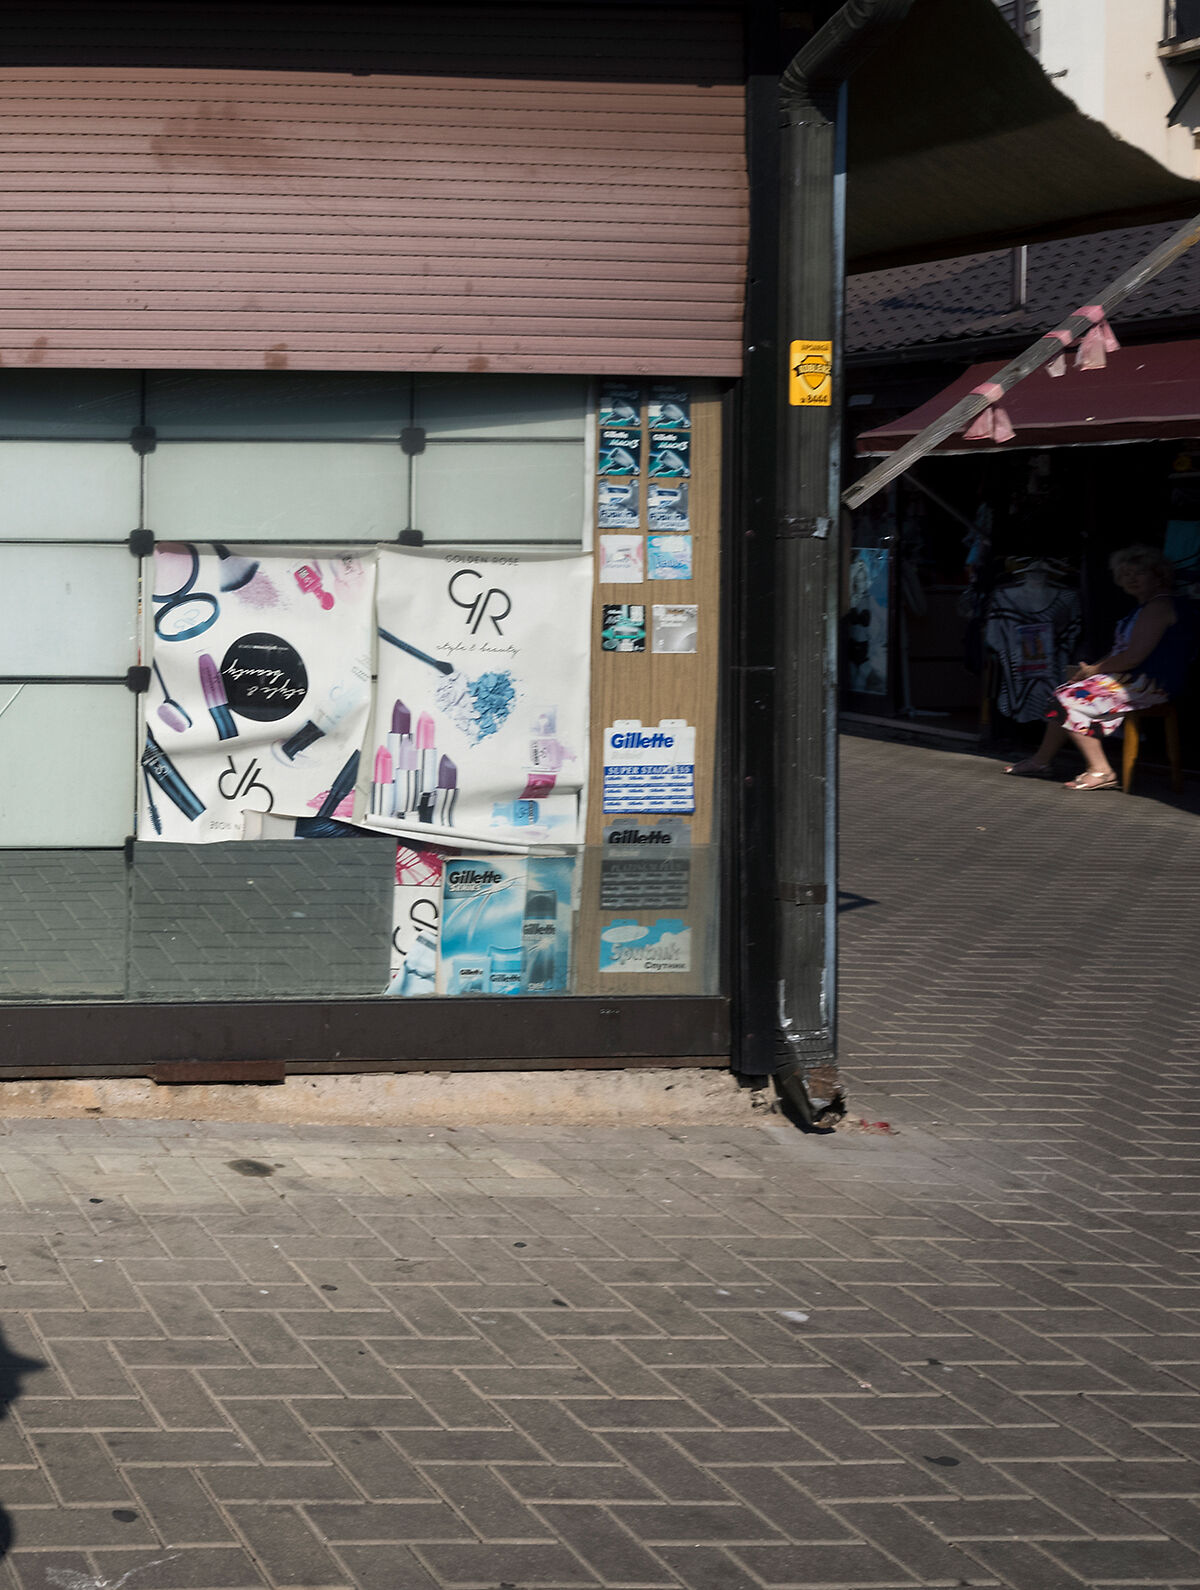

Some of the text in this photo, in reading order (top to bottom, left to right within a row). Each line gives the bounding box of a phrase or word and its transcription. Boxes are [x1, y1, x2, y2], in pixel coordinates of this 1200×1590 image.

[611, 732, 674, 749] Gillette
[608, 829, 673, 845] Gillette
[448, 870, 502, 885] Gillette
